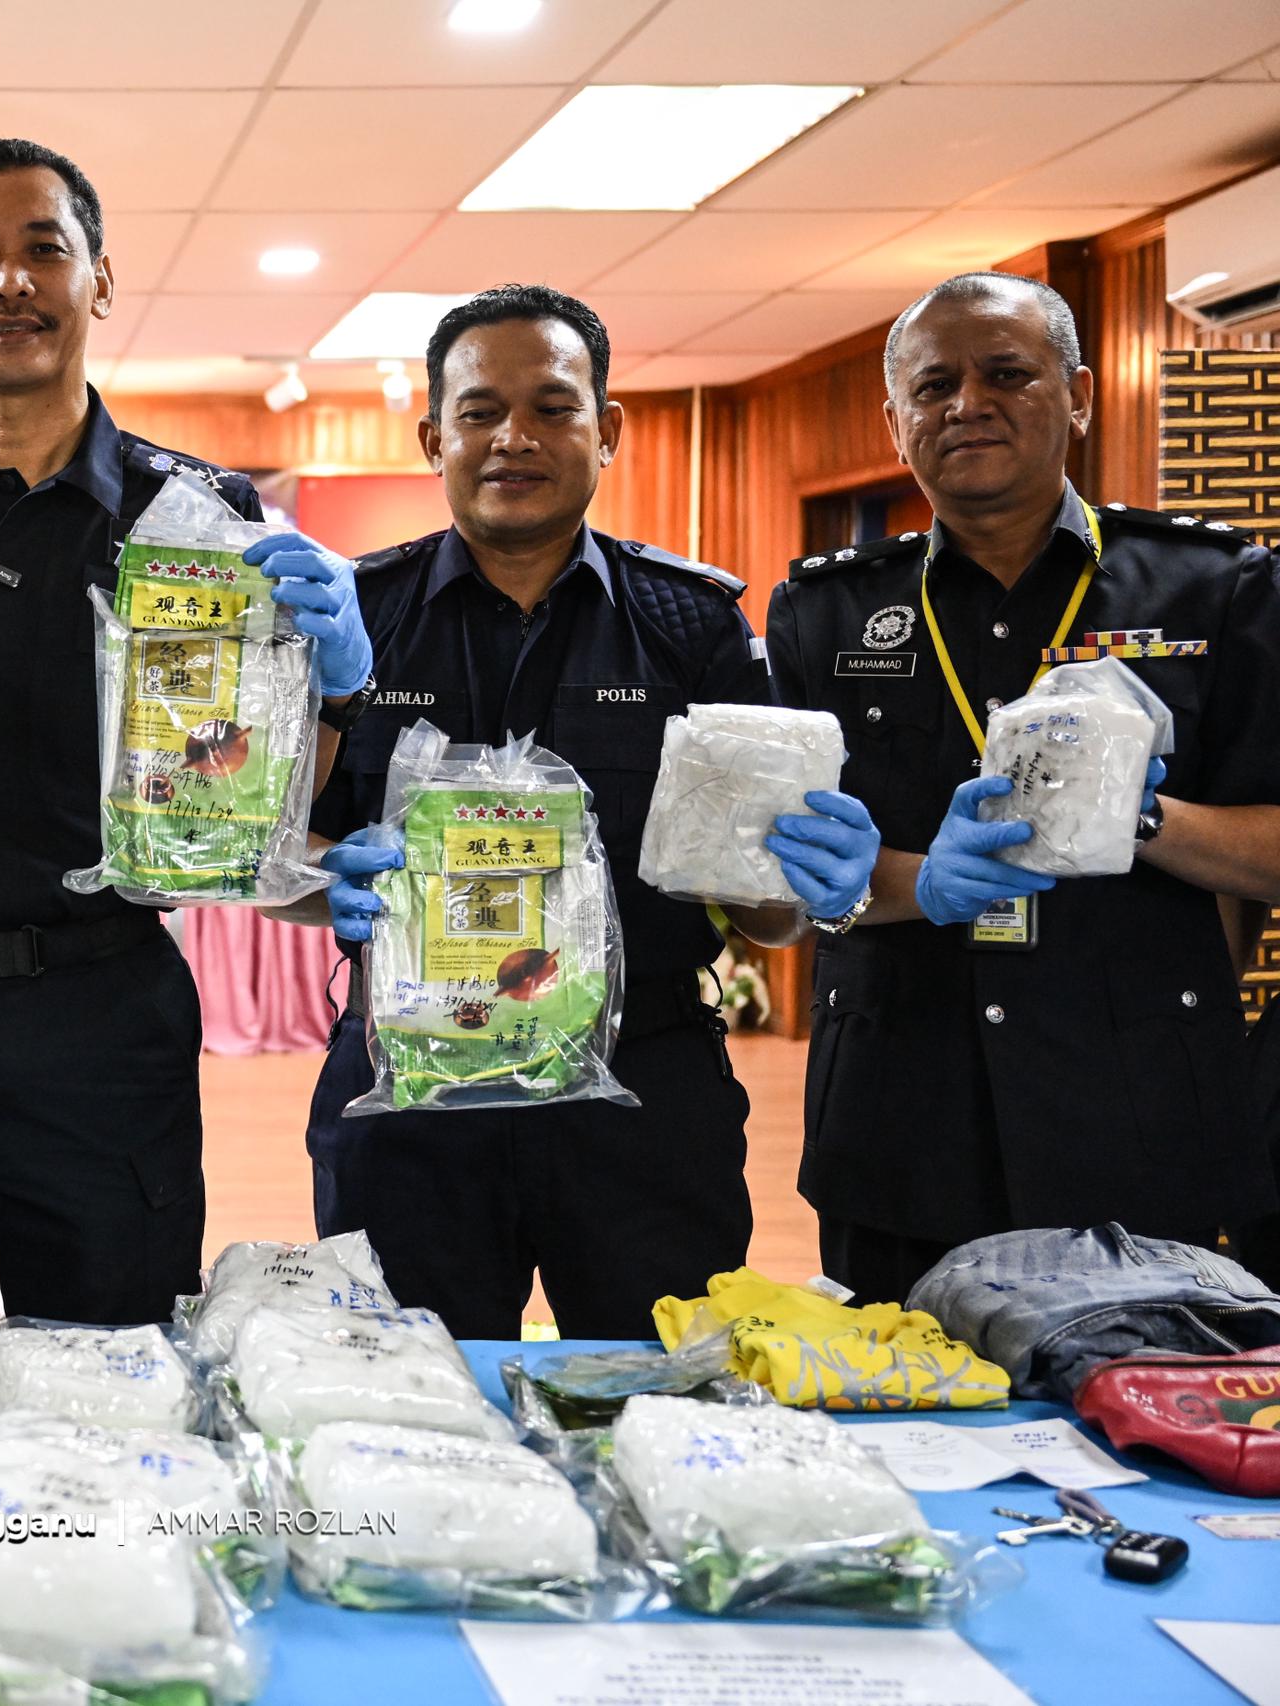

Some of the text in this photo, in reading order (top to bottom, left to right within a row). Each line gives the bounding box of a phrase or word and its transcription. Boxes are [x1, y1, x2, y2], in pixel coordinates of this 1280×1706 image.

[153, 595, 223, 618] 观音王
[848, 660, 902, 669] MUHAMMAD
[372, 691, 435, 705] AHMAD
[596, 688, 646, 702] POLIS
[465, 837, 537, 857] 观音王
[455, 856, 546, 867] GUANYINWANG
[1215, 1371, 1280, 1399] GU
